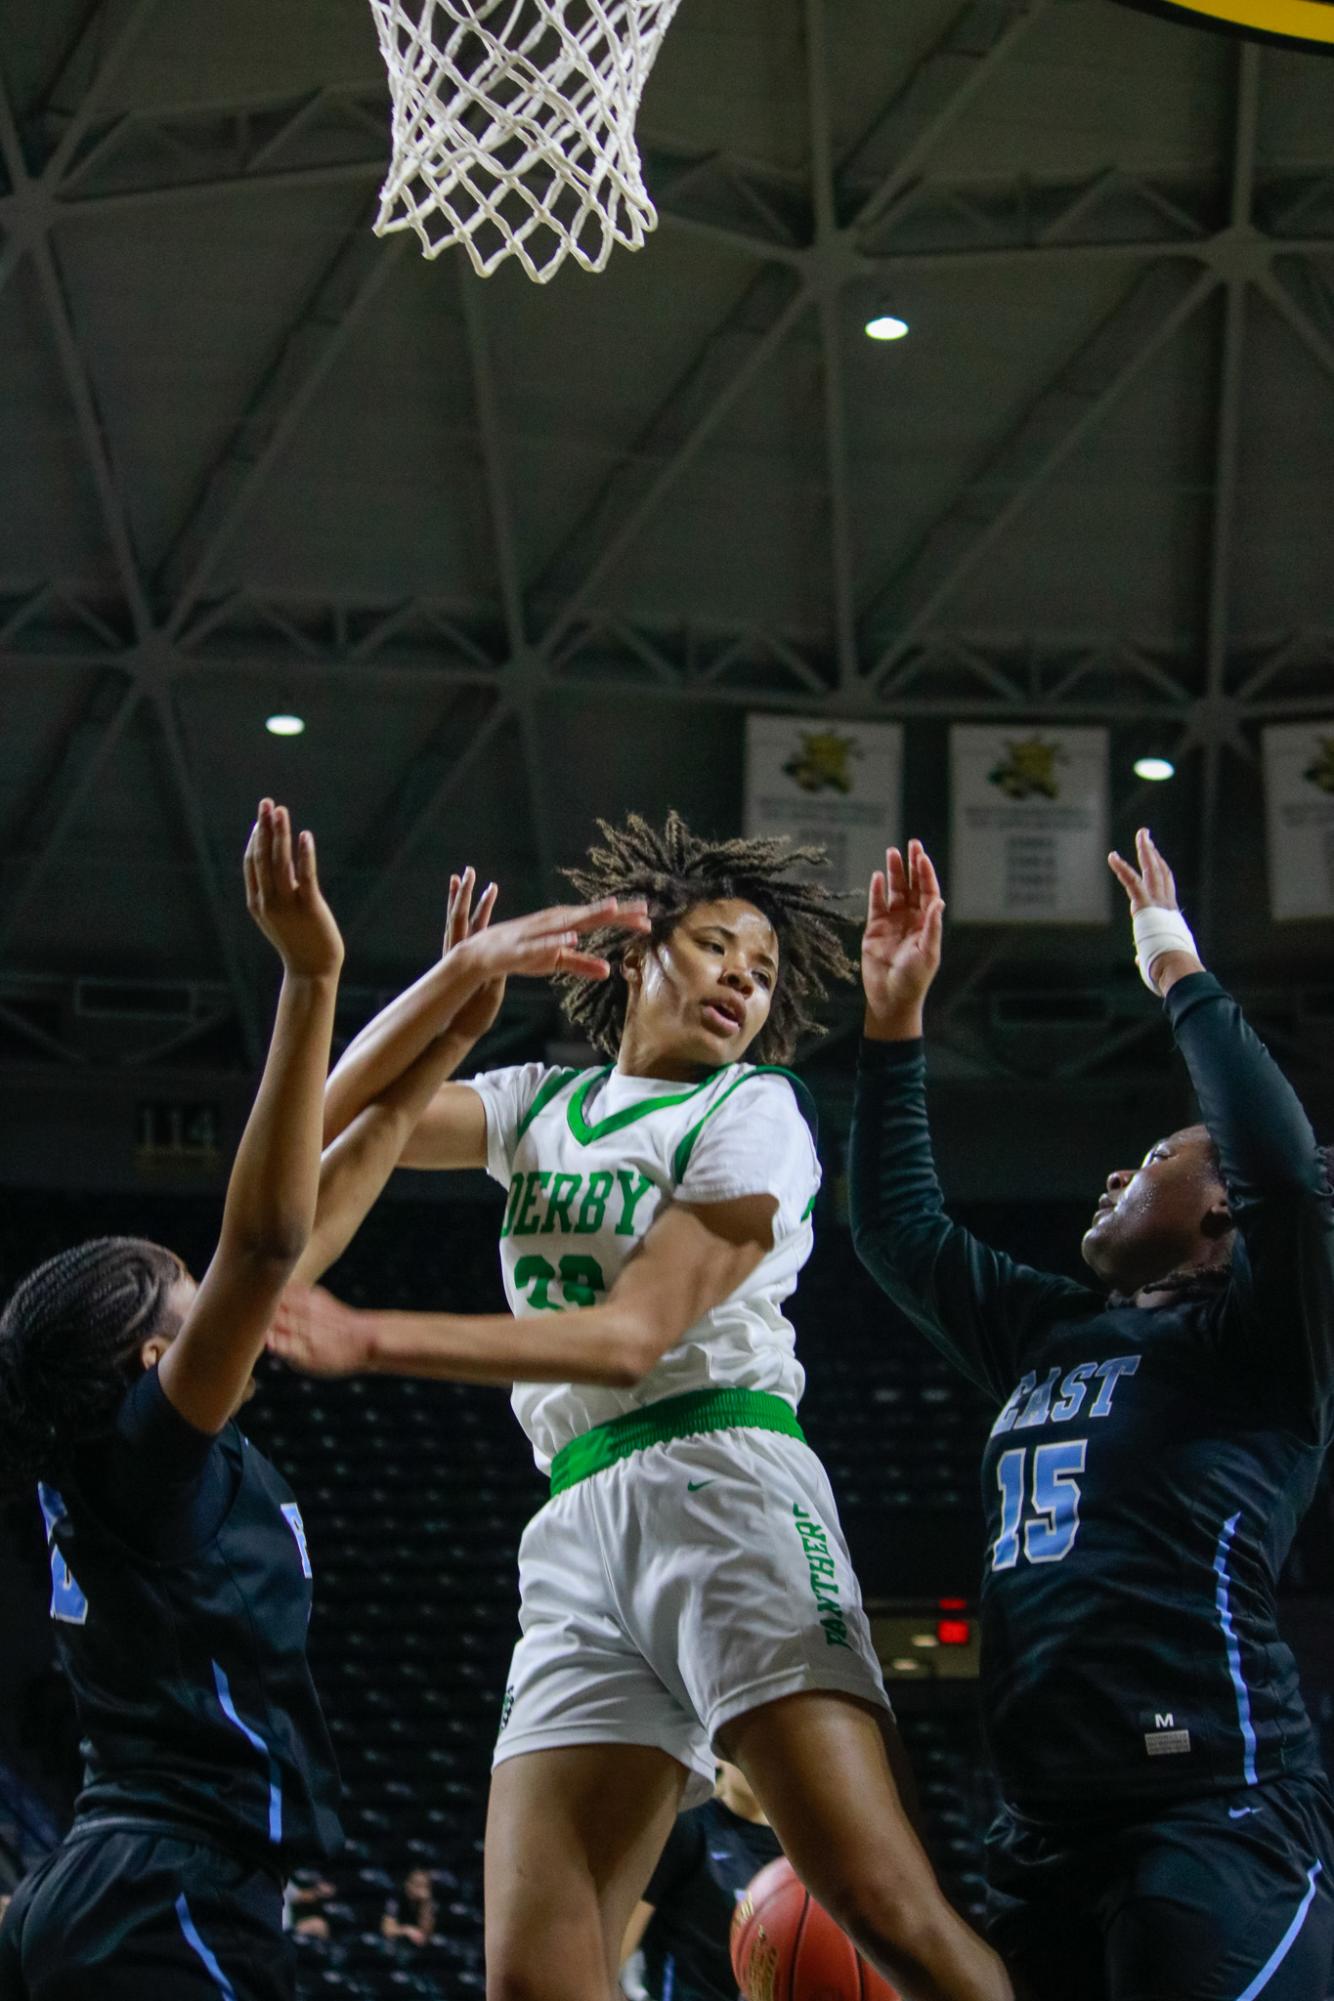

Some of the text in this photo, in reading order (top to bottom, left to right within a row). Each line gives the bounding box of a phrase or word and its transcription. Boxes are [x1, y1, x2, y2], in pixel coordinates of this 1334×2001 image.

[990, 1354, 1142, 1438] EAST
[992, 1439, 1088, 1571] 15
[1155, 1713, 1174, 1729] M
